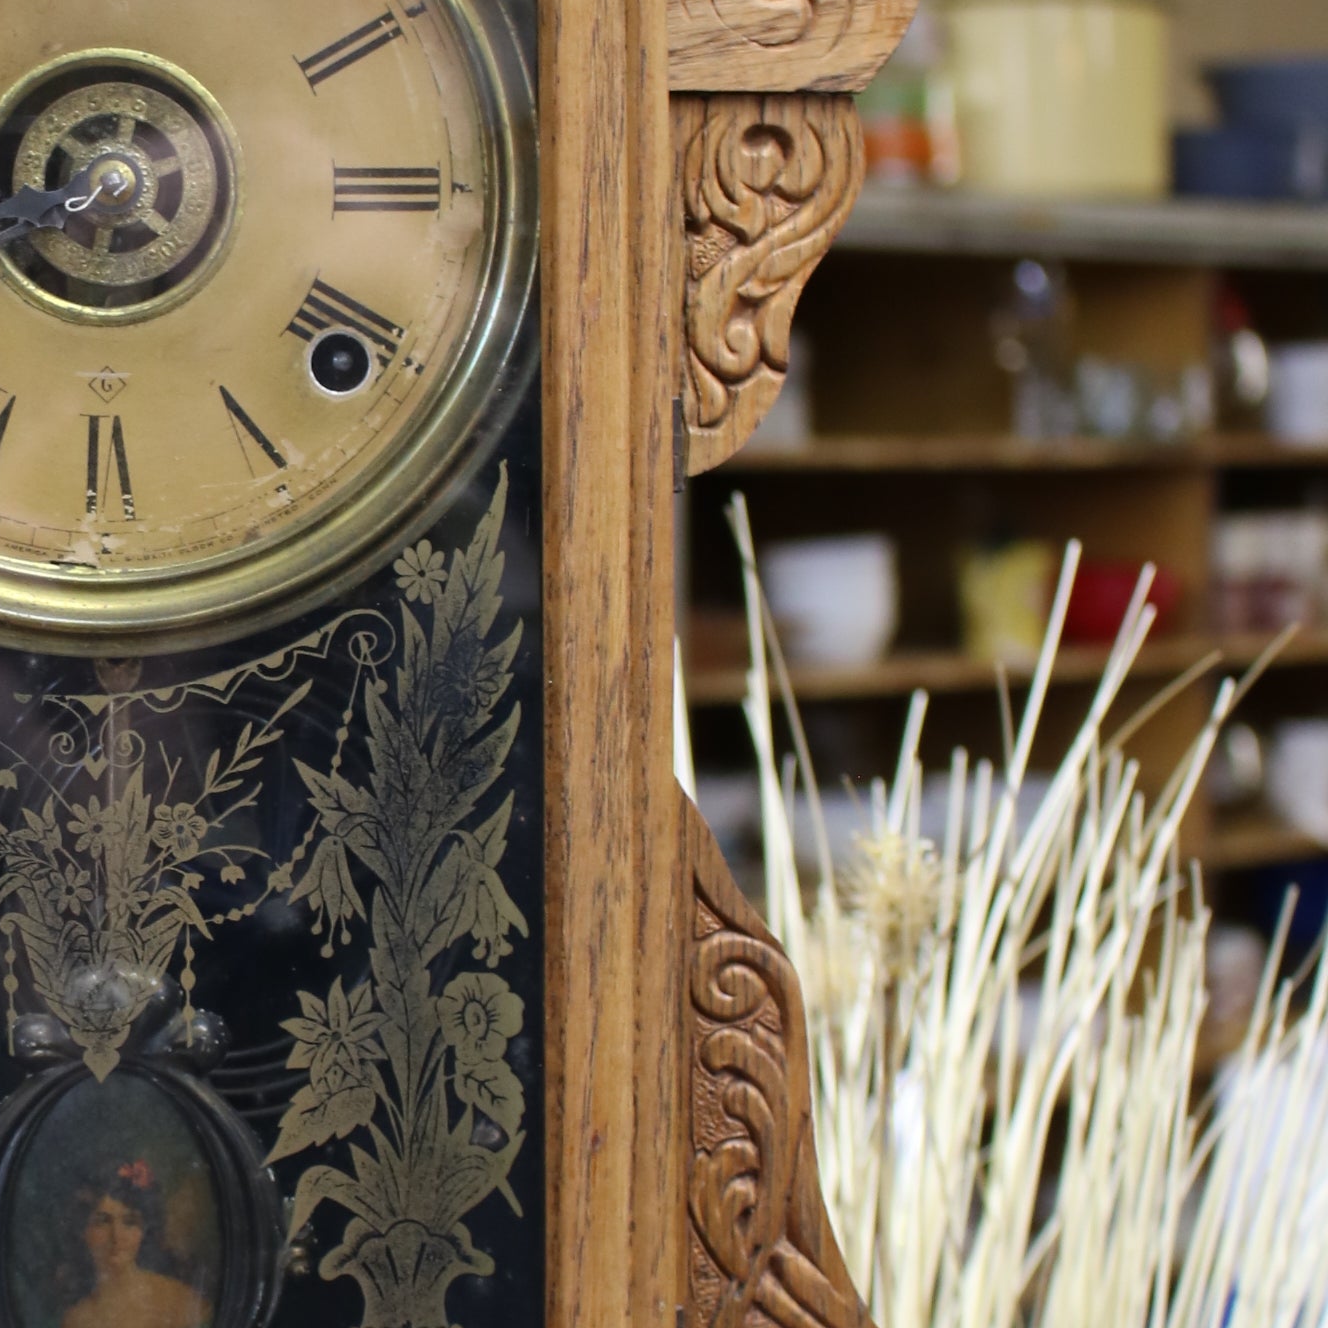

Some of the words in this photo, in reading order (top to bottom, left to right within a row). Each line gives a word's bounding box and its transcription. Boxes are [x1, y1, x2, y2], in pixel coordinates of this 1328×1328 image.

[292, 3, 408, 97] II
[331, 158, 441, 221] III
[75, 412, 147, 522] VI
[218, 384, 289, 480] V
